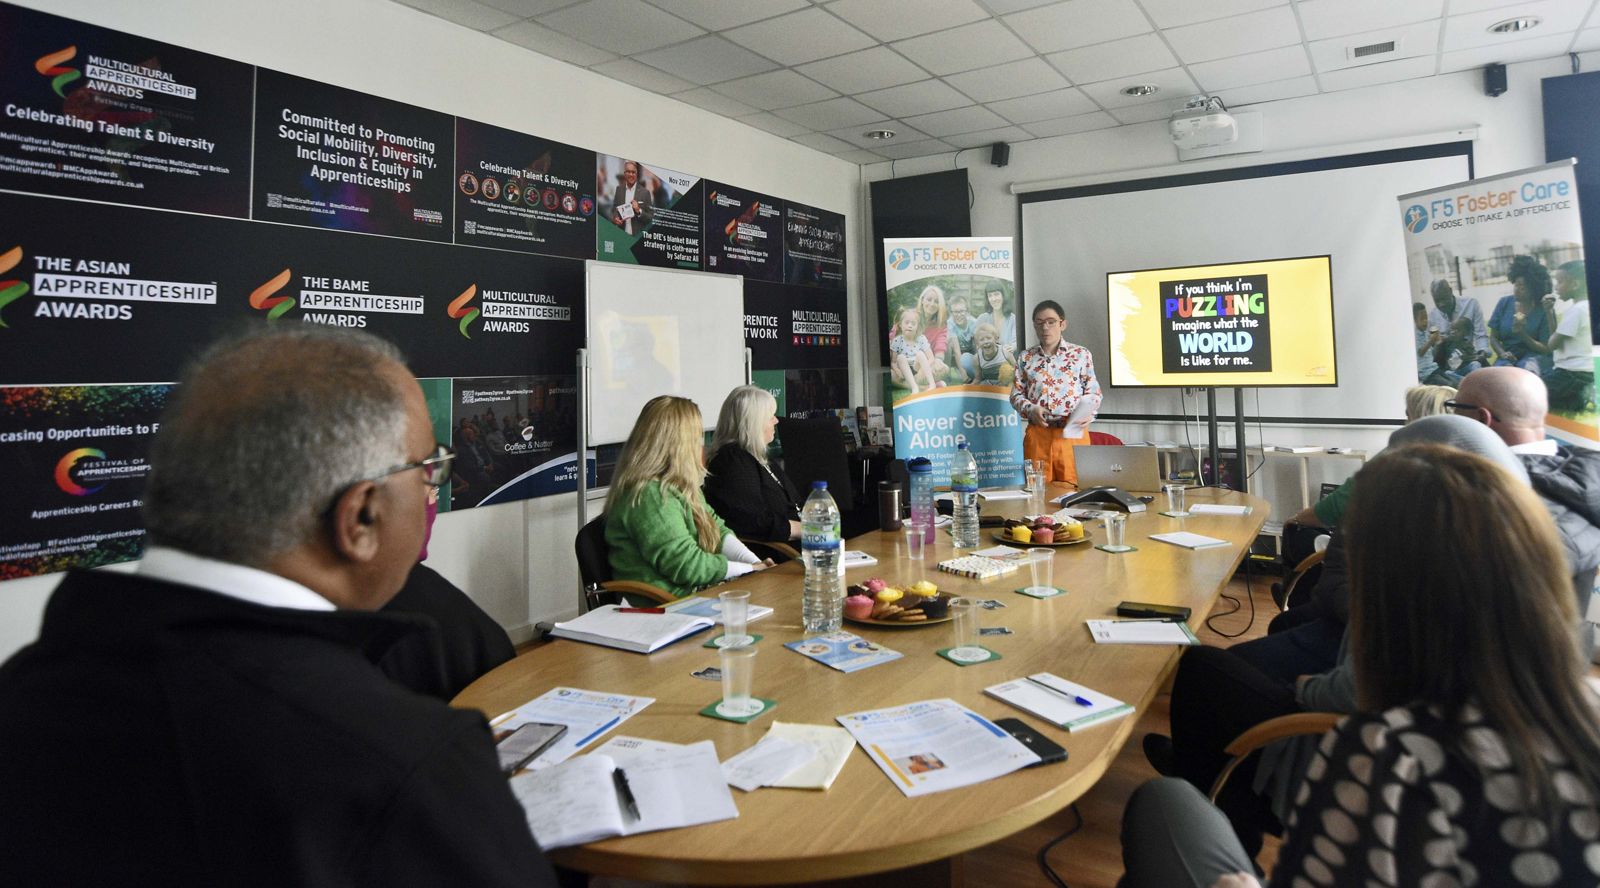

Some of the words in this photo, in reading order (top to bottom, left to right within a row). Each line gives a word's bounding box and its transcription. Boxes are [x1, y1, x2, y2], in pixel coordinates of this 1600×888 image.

[89, 55, 176, 82] MULTICULTURAL
[87, 80, 144, 99] AWARDS
[89, 67, 195, 97] APPRENTICESHIP
[6, 104, 94, 133] Celebrating
[98, 119, 141, 140] Talent
[145, 129, 154, 141] &
[158, 131, 215, 154] Diversity
[282, 108, 355, 136] Committed
[359, 125, 373, 139] to
[376, 128, 435, 154] Promoting
[278, 124, 320, 145] Social
[324, 133, 379, 158] Mobility,
[382, 145, 437, 169] Diversity,
[51, 140, 105, 155] Apprenticeship
[107, 149, 131, 159] Awards
[132, 153, 168, 165] recognises
[169, 159, 208, 171] Multicultural
[70, 150, 87, 159] their
[142, 161, 169, 172] learning
[296, 145, 356, 168] Inclusion
[359, 157, 369, 170] &
[372, 160, 409, 180] Equity
[412, 166, 423, 180] in
[310, 164, 411, 194] Apprenticeships
[480, 160, 521, 179] Celebrating
[522, 169, 543, 182] Talent
[544, 174, 550, 183] &
[550, 175, 579, 190] Diversity
[668, 176, 678, 184] Nov
[679, 178, 690, 187] 2017
[1431, 198, 1454, 219] F5
[1456, 189, 1517, 215] Foster
[1520, 180, 1569, 203] Care
[1432, 218, 1463, 231] CHOOSE
[1465, 216, 1475, 225] TO
[1476, 211, 1504, 223] MAKE
[1506, 210, 1512, 218] A
[1514, 200, 1571, 217] DIFFERENCE
[642, 230, 652, 239] The
[667, 235, 685, 244] blanket
[686, 237, 699, 246] BAME
[644, 240, 665, 251] strategy
[666, 251, 673, 260] by
[912, 247, 931, 261] F5
[933, 247, 978, 261] Foster
[980, 246, 1010, 260] Care
[35, 256, 71, 272] THE
[76, 259, 130, 276] ASIAN
[37, 277, 215, 301] APPRENTICESHIP
[302, 276, 330, 290] THE
[333, 278, 370, 292] BAME
[1175, 284, 1183, 295] If
[1186, 285, 1204, 298] you
[1206, 281, 1233, 293] think
[1236, 278, 1252, 291] I'm
[303, 294, 423, 311] APPRENTICESHIP
[482, 290, 557, 304] MULTICULTURAL
[35, 301, 133, 320] AWARDS
[483, 304, 570, 319] APPRENTICESHIP
[1165, 293, 1265, 319] PUZZLING
[302, 312, 367, 328] AWARDS
[792, 310, 841, 323] MULTICULTURAL
[1172, 320, 1211, 333] Imagine
[1214, 318, 1238, 329] what
[1240, 317, 1259, 328] the
[483, 320, 530, 333] AWARDS
[794, 323, 840, 333] APPRENTICESHIP
[793, 336, 841, 345] ALLIANCE
[1178, 331, 1253, 354] WORLD
[1181, 356, 1190, 366] Is
[1192, 355, 1211, 366] like
[1213, 354, 1230, 366] for
[1233, 356, 1253, 366] me.
[898, 415, 957, 433] Never
[963, 411, 1018, 429] Stand
[48, 425, 133, 441] Opportunities
[137, 424, 149, 434] to
[504, 442, 526, 452] Coffee
[528, 441, 533, 449] &
[77, 464, 152, 476] APPRENTICESHIPS
[83, 460, 128, 468] FESTIVAL
[554, 474, 567, 482] learn
[31, 504, 97, 519] Apprenticeship
[99, 501, 131, 511] Careers
